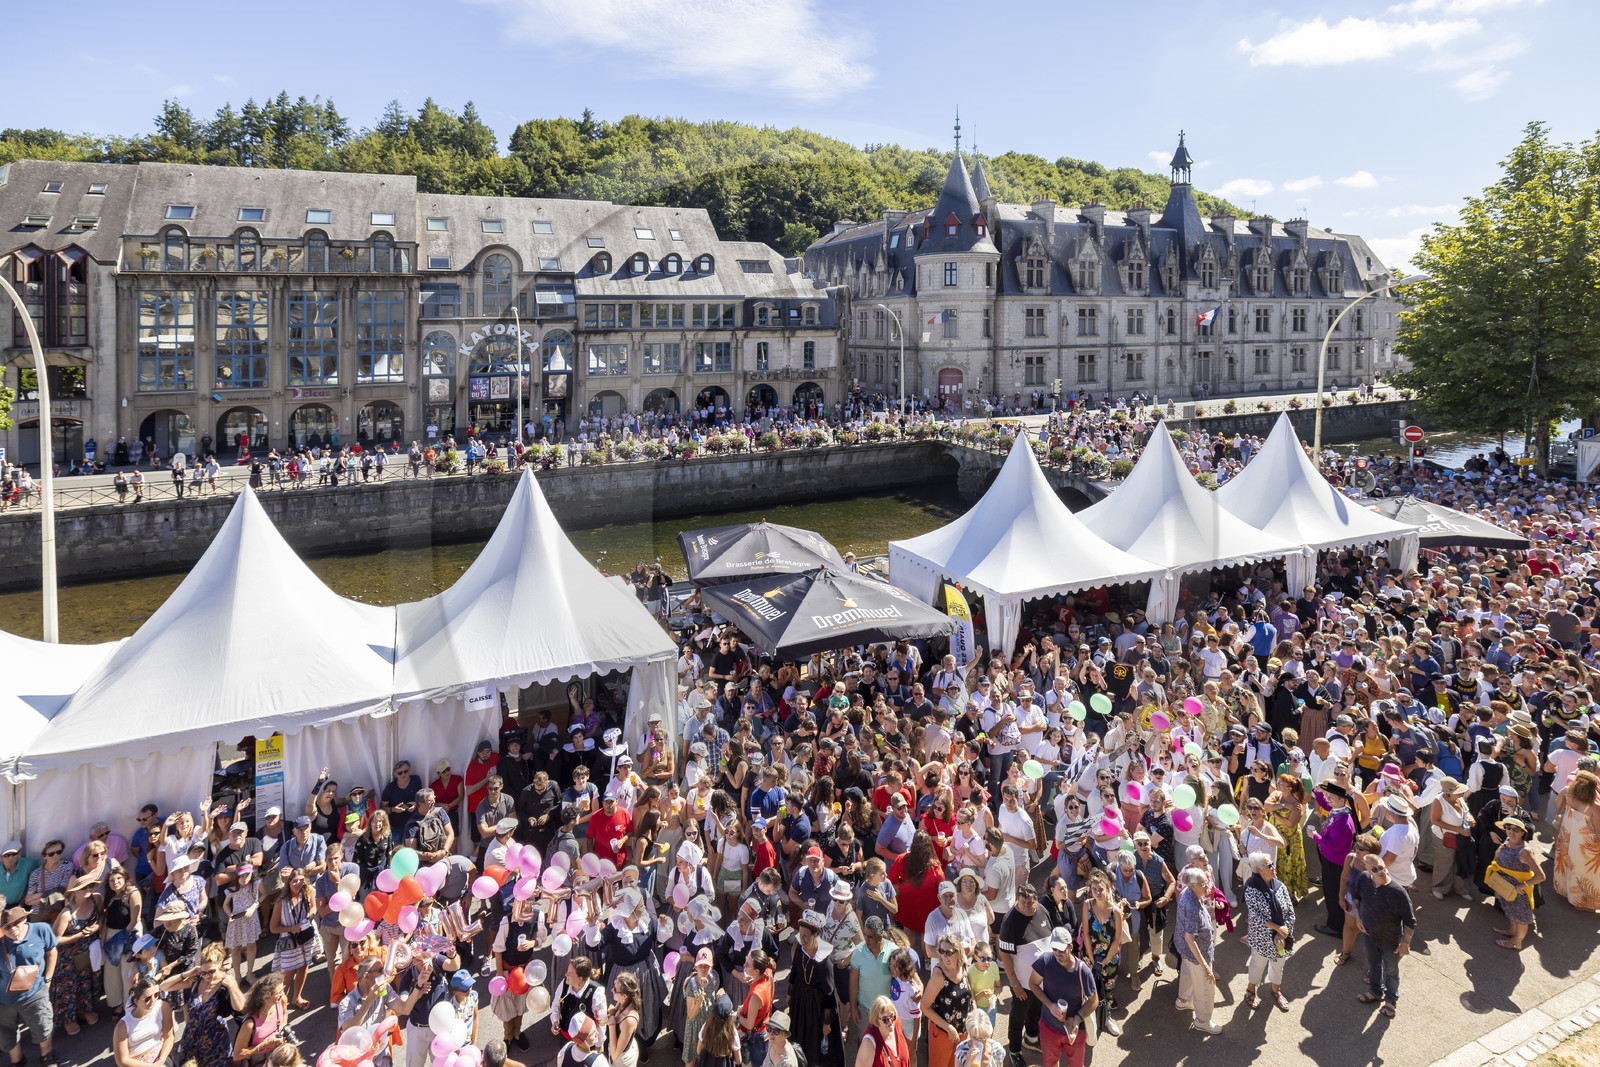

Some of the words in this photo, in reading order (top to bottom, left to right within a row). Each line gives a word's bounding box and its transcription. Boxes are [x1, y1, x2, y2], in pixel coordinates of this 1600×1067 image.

[459, 323, 540, 356] KATORZA
[1585, 430, 1591, 438] P
[726, 559, 763, 568] Brasserie
[776, 558, 811, 568] Bretagne
[469, 694, 493, 703] CAISSE
[265, 739, 275, 749] K
